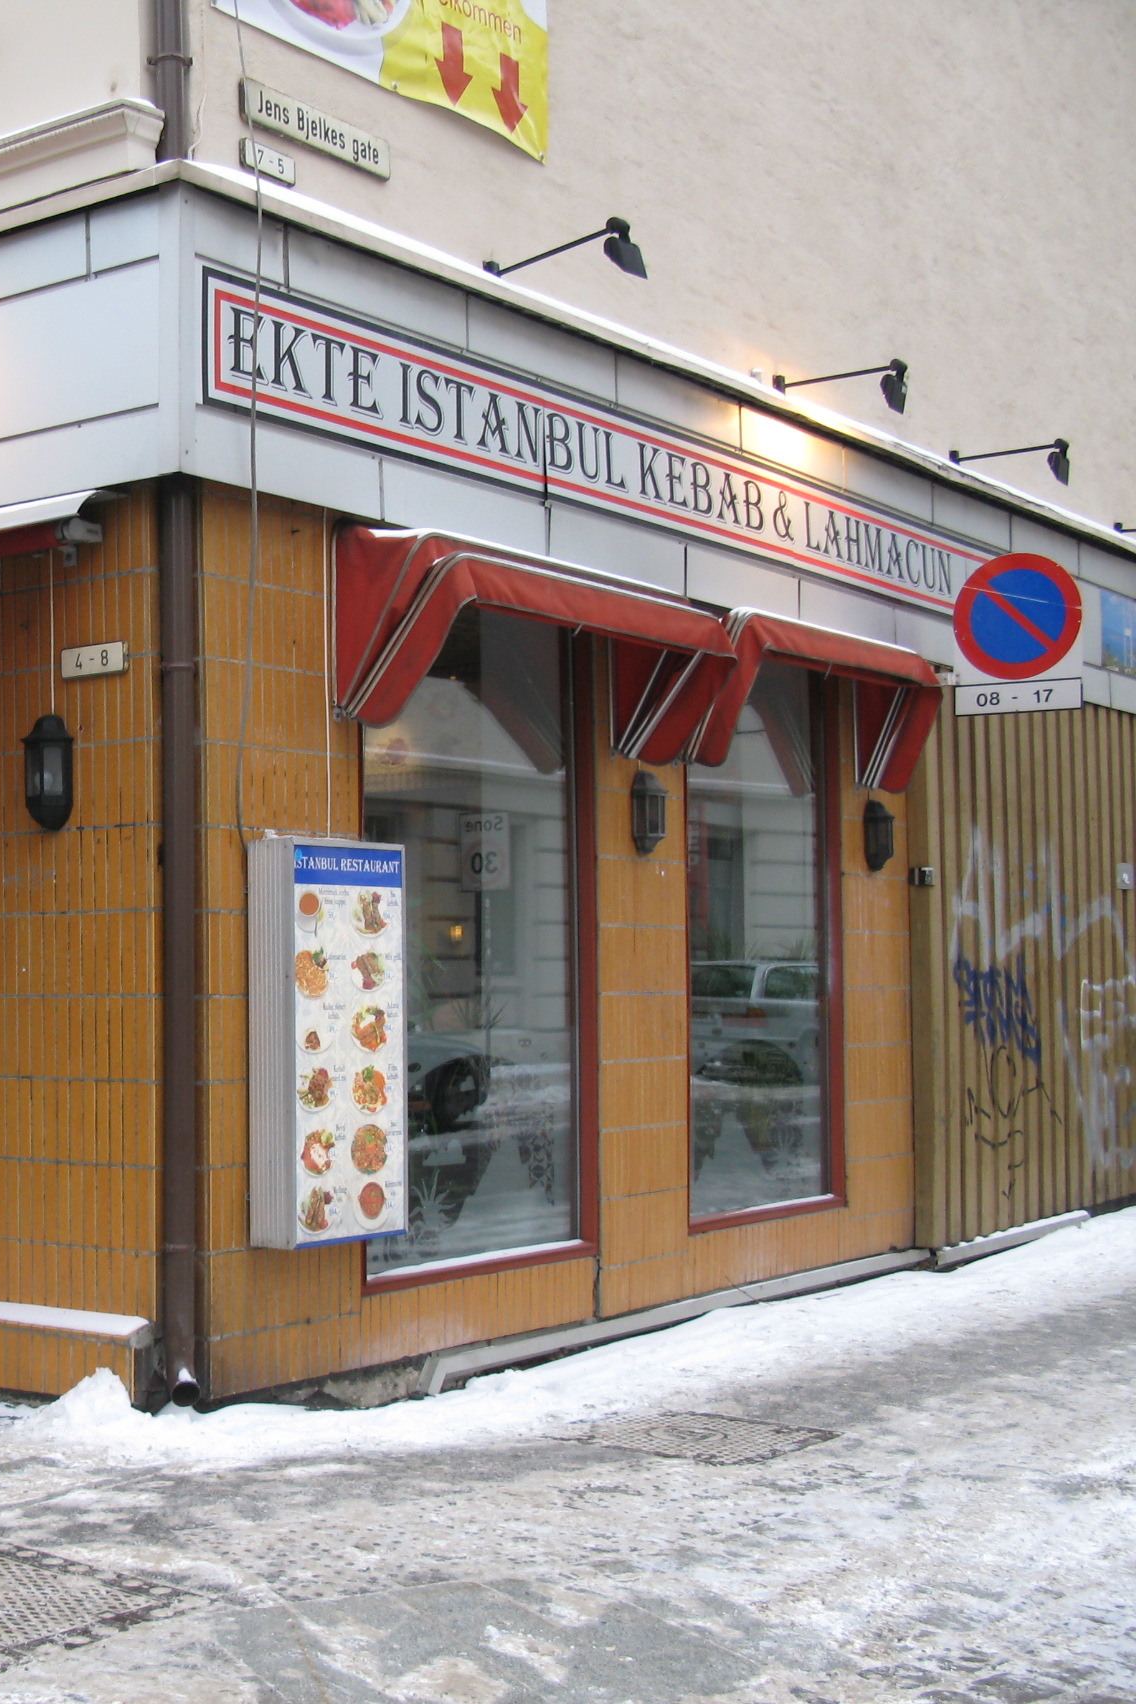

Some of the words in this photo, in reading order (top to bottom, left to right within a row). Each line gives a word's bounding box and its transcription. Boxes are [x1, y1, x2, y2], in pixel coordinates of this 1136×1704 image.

[258, 90, 290, 125] Jens
[297, 107, 346, 150] Bjelkes
[352, 138, 379, 165] gate
[258, 149, 264, 165] 7
[278, 158, 285, 175] 5
[227, 306, 384, 421] EKTE
[398, 361, 629, 493] ISTANBUL
[637, 441, 764, 535] KEBAB
[773, 489, 795, 542] &
[803, 499, 953, 598] LAHMACUN
[75, 652, 83, 670] 4
[100, 649, 109, 667] 8
[976, 691, 1001, 709] 08
[1033, 687, 1054, 705] 17
[340, 858, 400, 874] RESTAURANT
